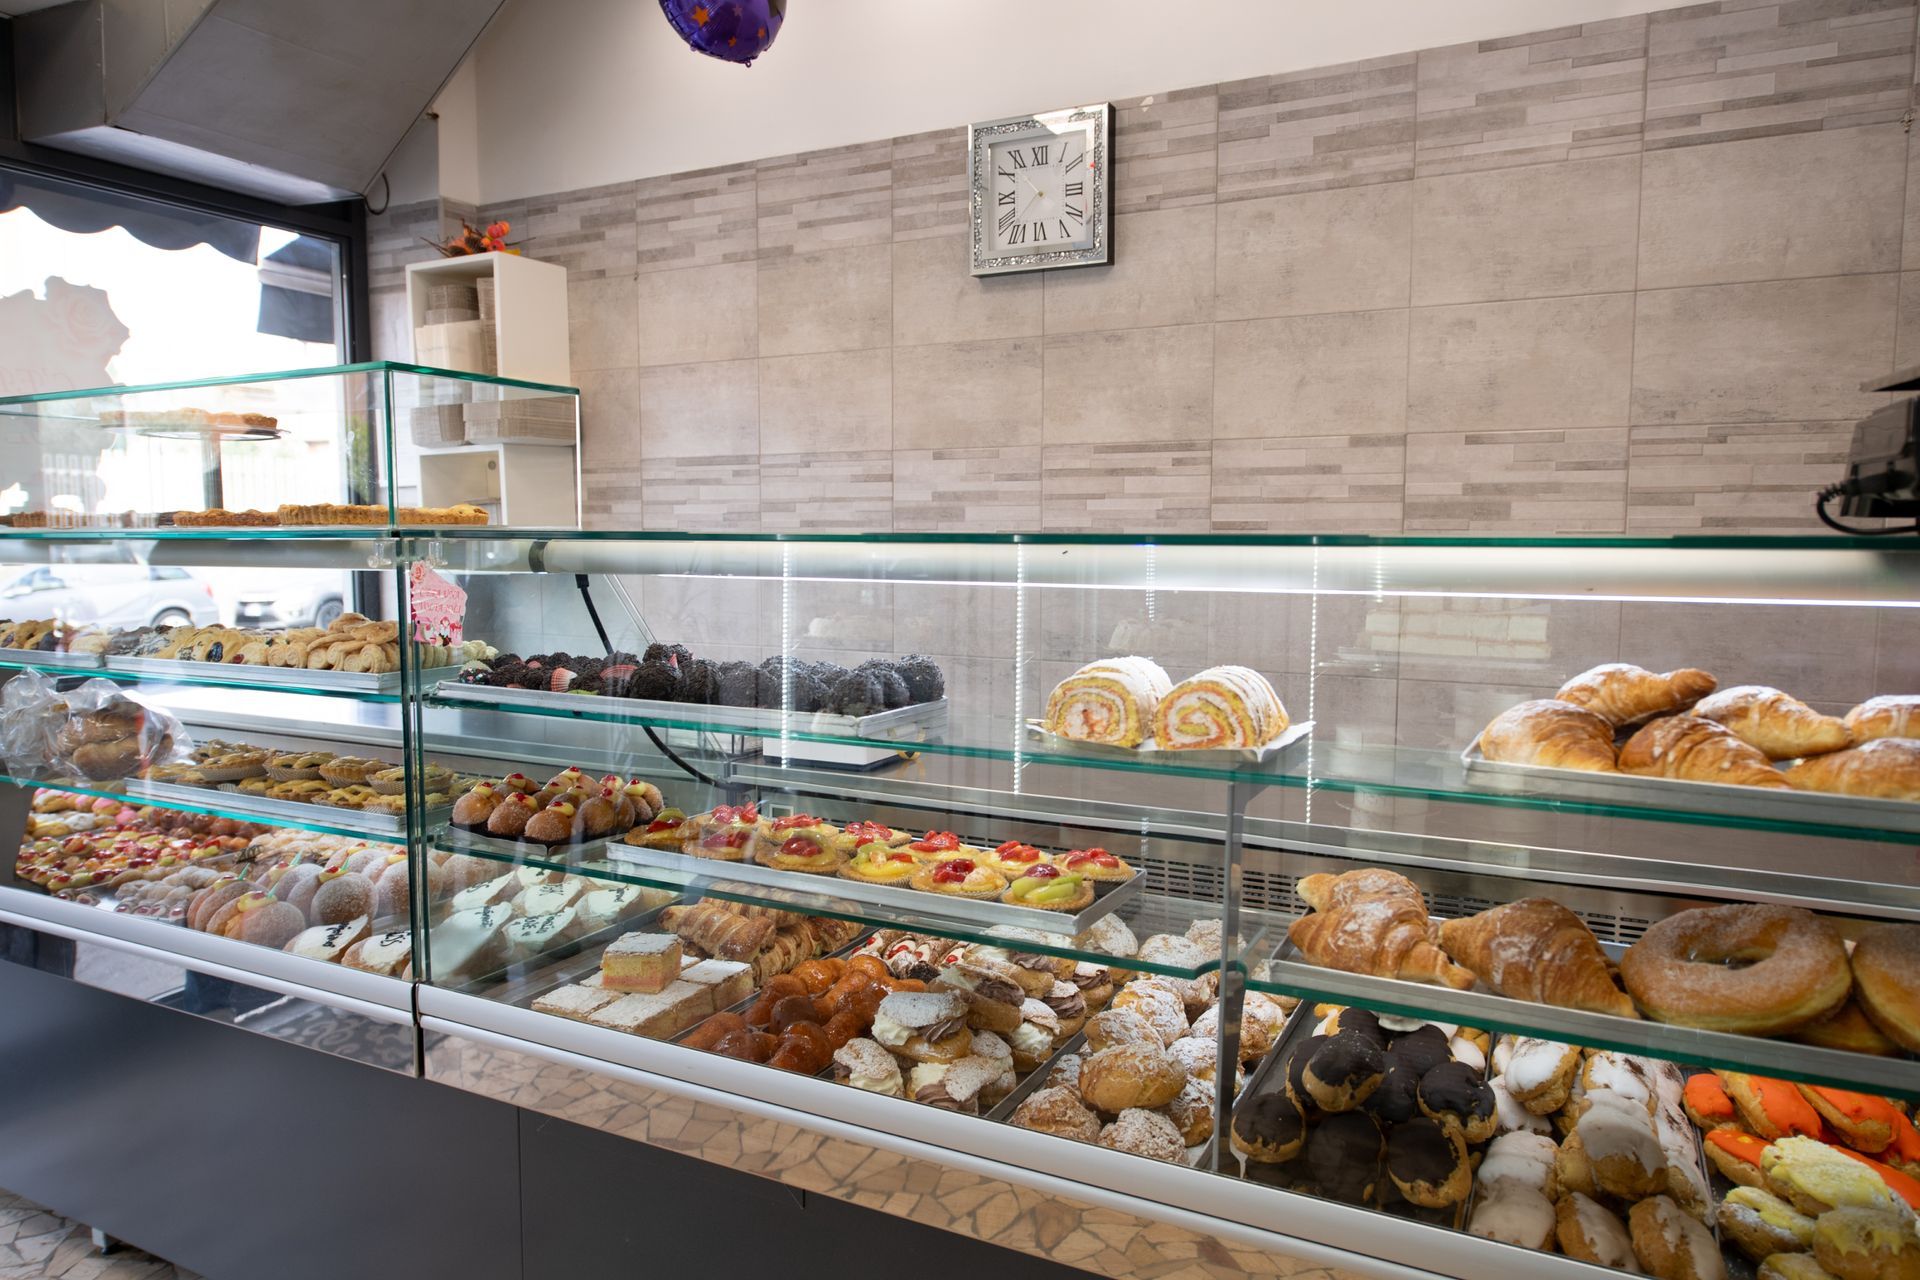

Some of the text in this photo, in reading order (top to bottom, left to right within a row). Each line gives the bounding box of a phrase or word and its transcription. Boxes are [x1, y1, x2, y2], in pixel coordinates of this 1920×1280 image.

[1008, 150, 1026, 169] XI
[1032, 145, 1048, 167] XII
[1058, 142, 1068, 163] I
[999, 165, 1016, 183] X
[1066, 153, 1083, 175] II
[999, 190, 1016, 206] IX
[1066, 182, 1083, 197] III
[999, 209, 1016, 236] VIII
[1066, 203, 1083, 226] IV
[1008, 224, 1026, 245] VII
[1033, 222, 1047, 242] VI
[1059, 219, 1072, 238] V
